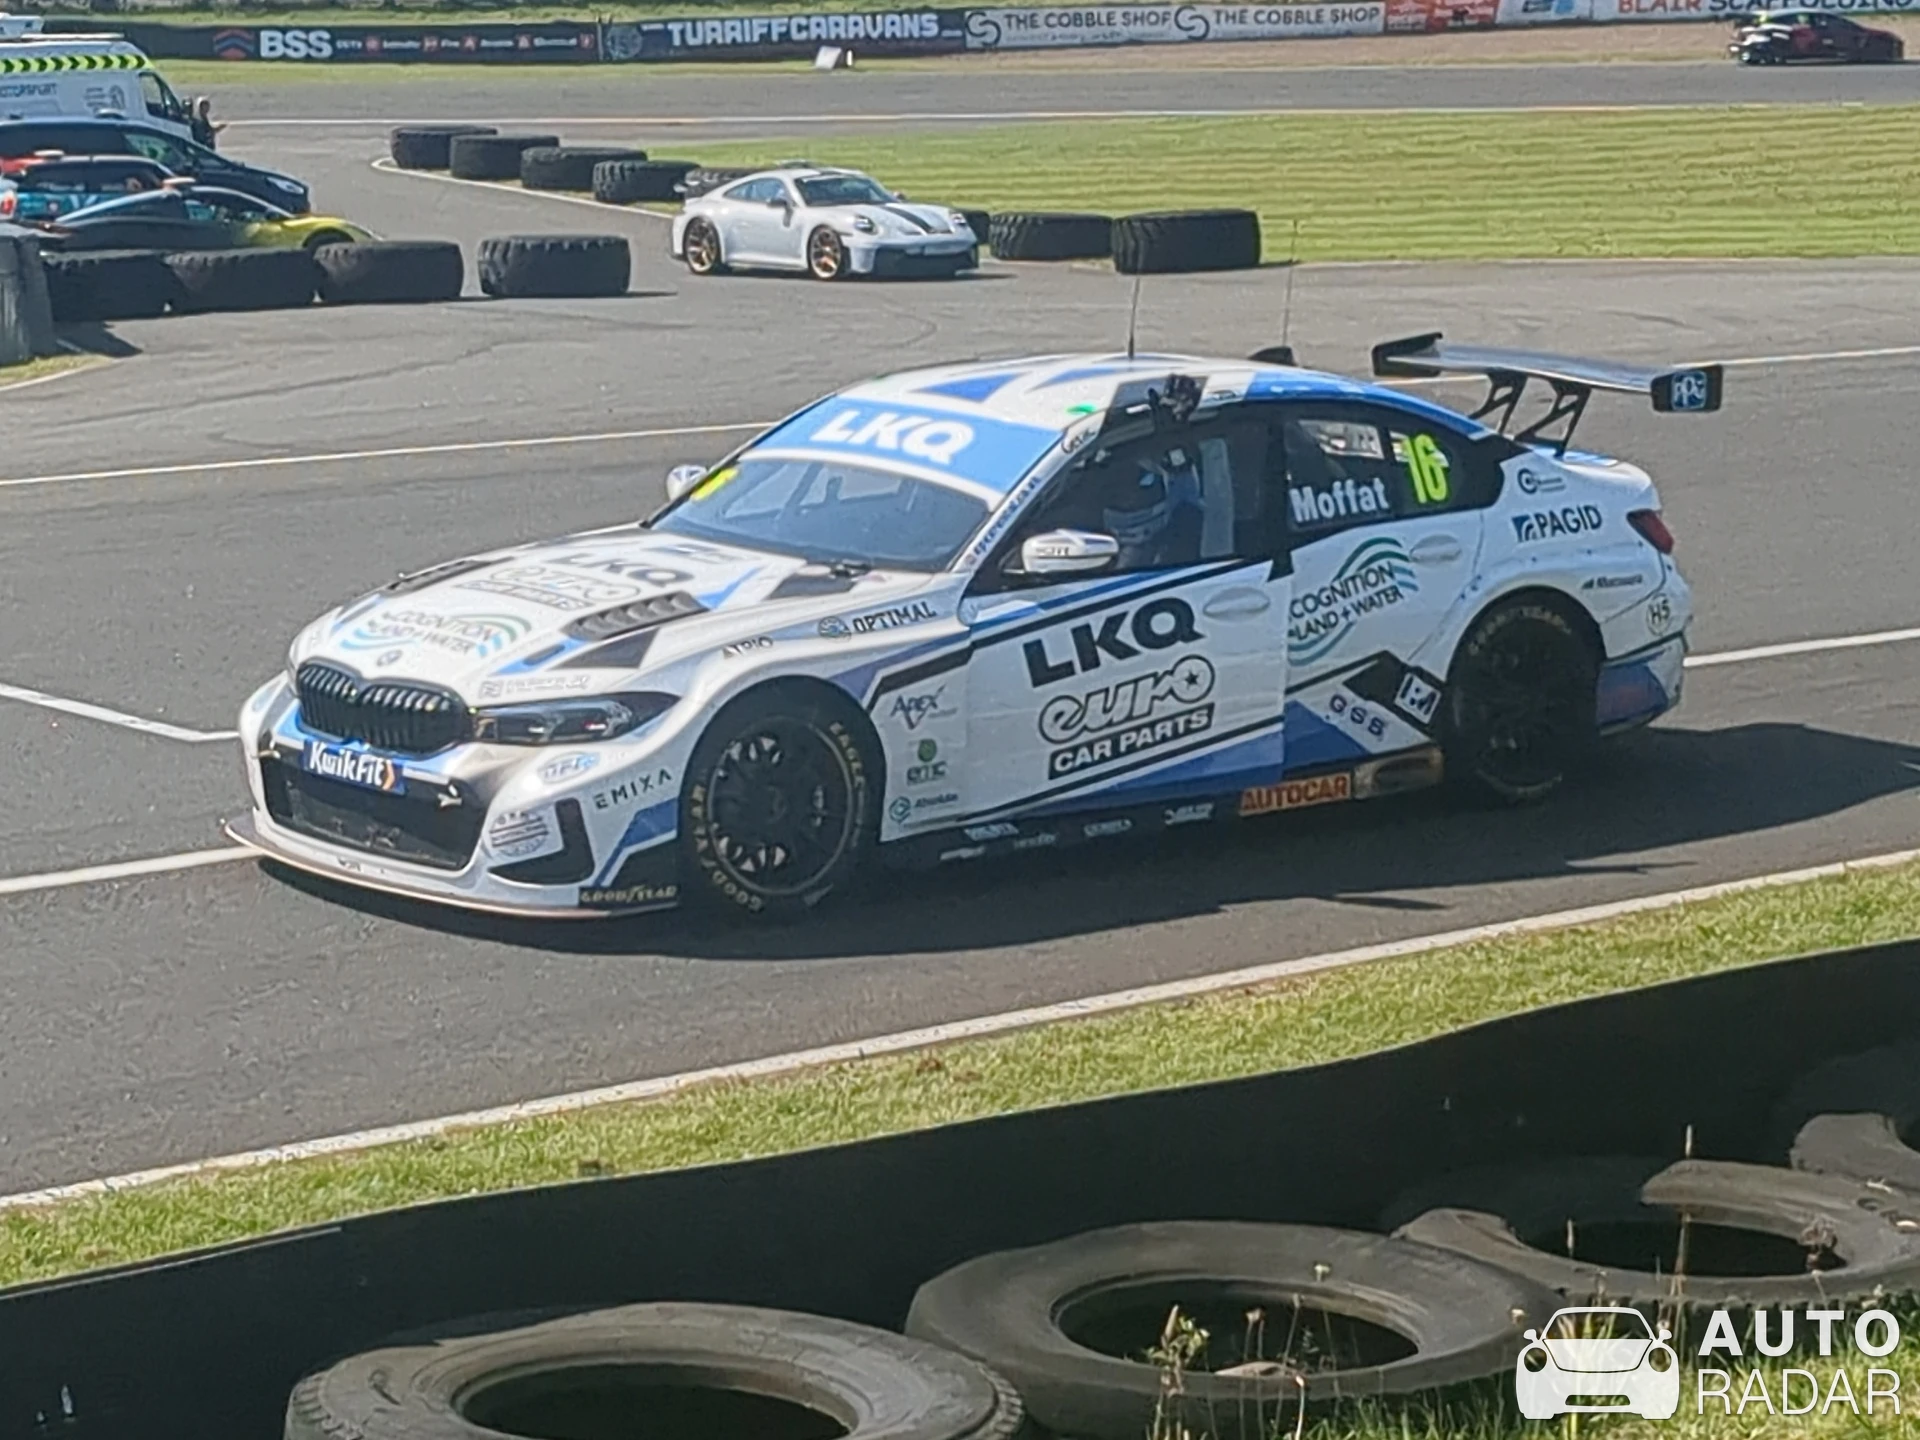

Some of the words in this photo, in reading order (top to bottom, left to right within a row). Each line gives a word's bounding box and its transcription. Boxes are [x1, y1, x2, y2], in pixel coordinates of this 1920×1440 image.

[1005, 13, 1041, 30] THE
[1044, 11, 1117, 28] COBBLE
[1121, 10, 1172, 27] SHOP
[1213, 9, 1248, 25] THE
[1253, 8, 1325, 25] COBBLE
[1326, 7, 1380, 24] SHOP
[1618, 0, 1702, 13] BLAIR
[260, 30, 332, 58] BSS
[810, 410, 974, 466] LKQ
[1404, 433, 1448, 503] 16
[1288, 477, 1390, 523] Moffat
[1533, 504, 1603, 539] PAGID
[1289, 560, 1396, 619] COGNITION
[852, 602, 937, 634] OPTIMAL
[1295, 610, 1340, 641] LAND
[1350, 585, 1404, 617] WATER
[1022, 597, 1206, 688] LKQ
[1038, 654, 1216, 744] euro
[1053, 738, 1112, 773] CAR
[1119, 709, 1210, 753] PARTS
[1242, 776, 1348, 811] AUTOCAR
